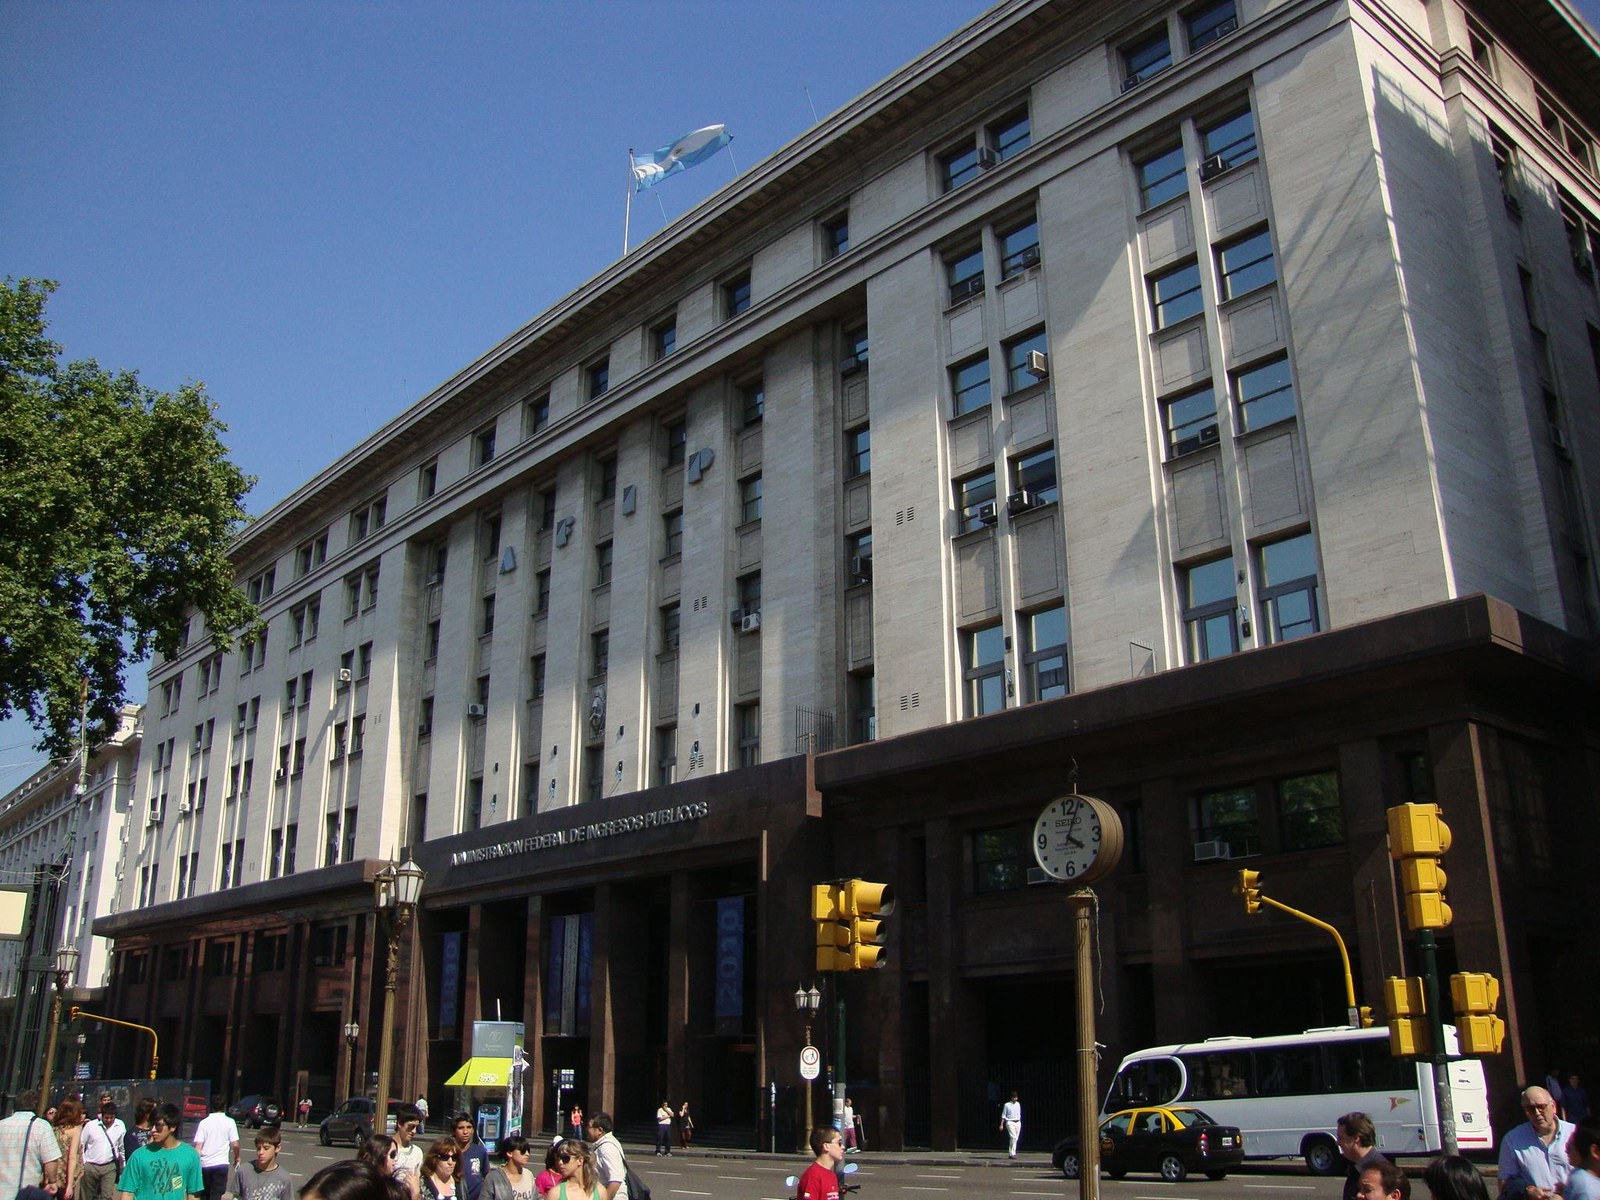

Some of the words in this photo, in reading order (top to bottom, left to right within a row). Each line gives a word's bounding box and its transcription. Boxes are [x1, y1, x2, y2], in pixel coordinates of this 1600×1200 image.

[1060, 799, 1075, 816] 12
[1055, 817, 1082, 828] SEIKO
[450, 839, 524, 866] ADMINISTRACION
[524, 831, 568, 852] FEDERAL
[569, 826, 585, 843] DE
[586, 814, 644, 840] INGRESOS
[1038, 833, 1047, 849] 9
[1091, 825, 1101, 842] 3
[1065, 860, 1075, 877] 6
